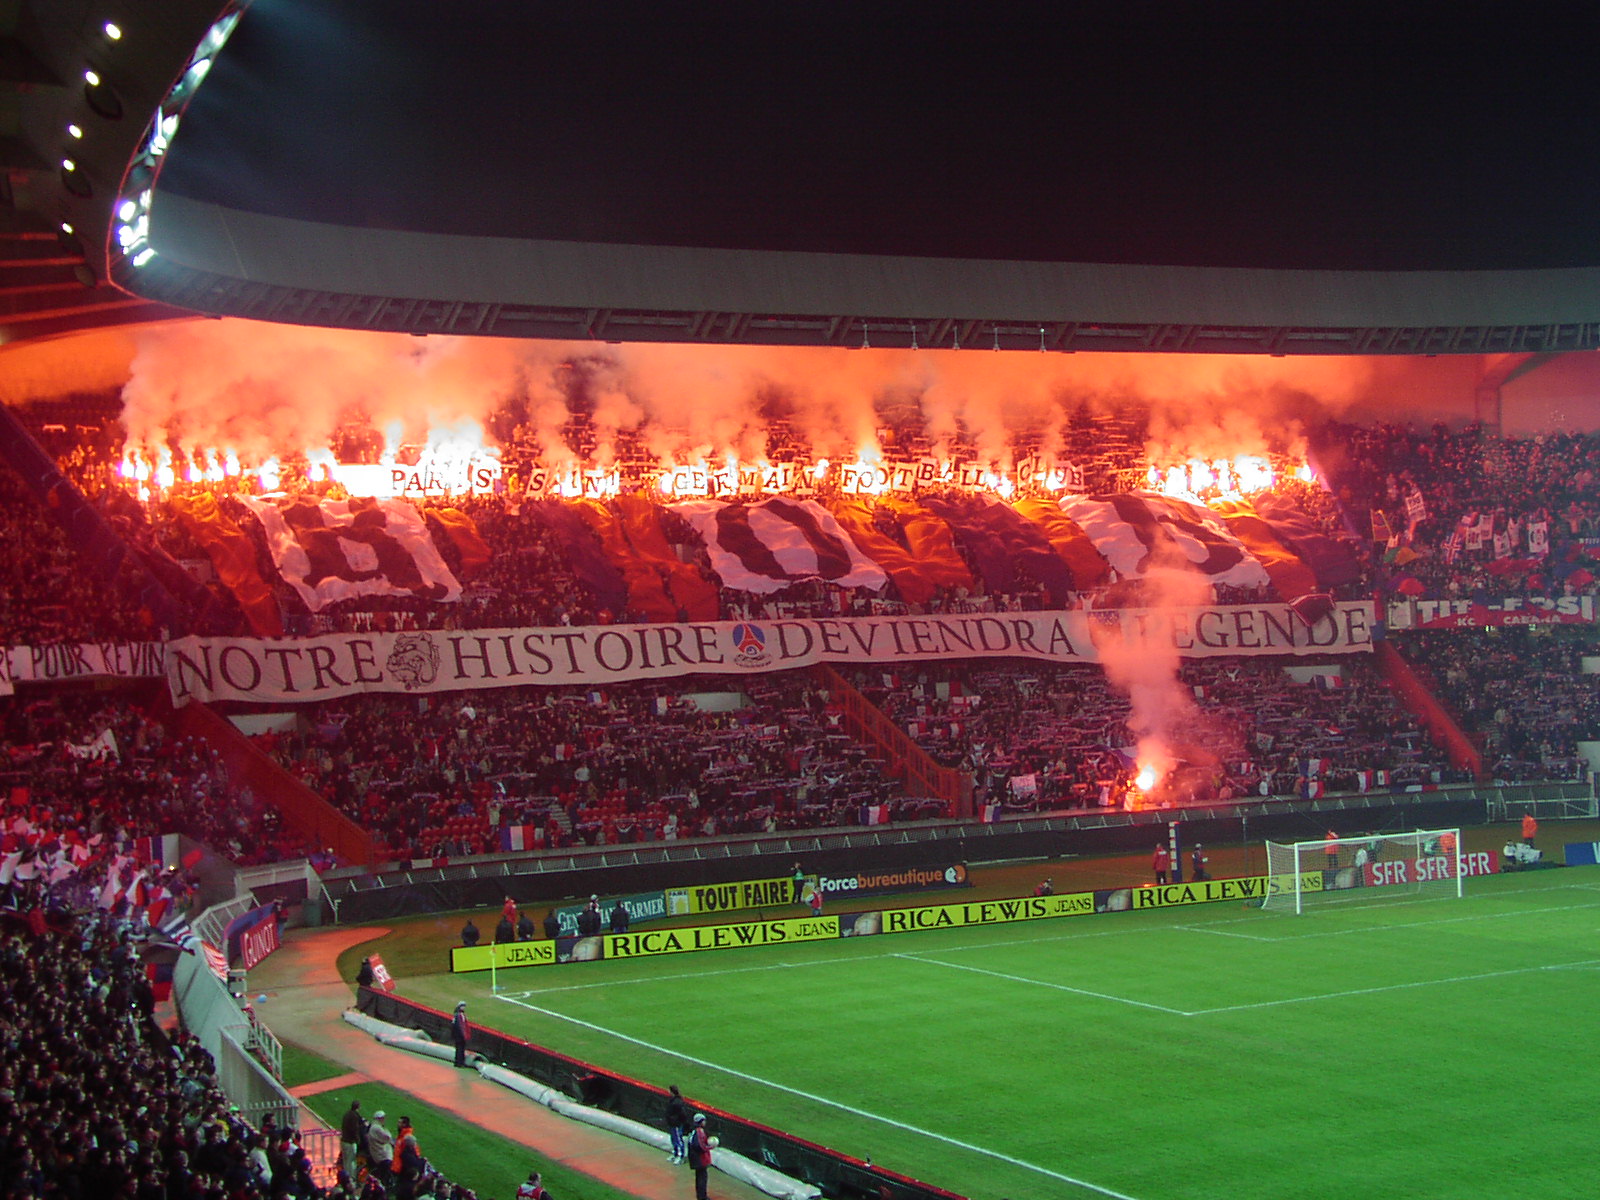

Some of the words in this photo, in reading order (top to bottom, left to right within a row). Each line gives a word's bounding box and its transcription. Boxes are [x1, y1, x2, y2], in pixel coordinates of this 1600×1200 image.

[391, 468, 493, 491] PARS
[529, 470, 617, 493] SIN
[675, 468, 816, 493] GERMAIN
[1019, 456, 1083, 486] CLUB
[1416, 595, 1594, 624] TIT-FOSI
[31, 643, 94, 679] POUR
[100, 641, 165, 676] KEVIN
[172, 638, 384, 699] NOTRE
[447, 625, 725, 680] HISTOIRE
[771, 617, 1080, 661] DEVIENDRA
[1372, 860, 1407, 886] SFR
[1415, 855, 1450, 882] SFR
[1460, 851, 1491, 877] SFR
[625, 898, 666, 920] FARMER
[696, 884, 738, 911] TOUT
[743, 879, 790, 908] FAIRE
[1139, 884, 1197, 908] RICA
[1205, 876, 1281, 900] LEWIS
[889, 908, 954, 931] RICA
[963, 898, 1047, 924] LEWIS
[1054, 896, 1092, 913] JEANS
[506, 944, 553, 963] JEANS
[611, 928, 686, 958] RICA
[693, 921, 787, 950] LEWIS
[794, 920, 838, 938] JEANS
